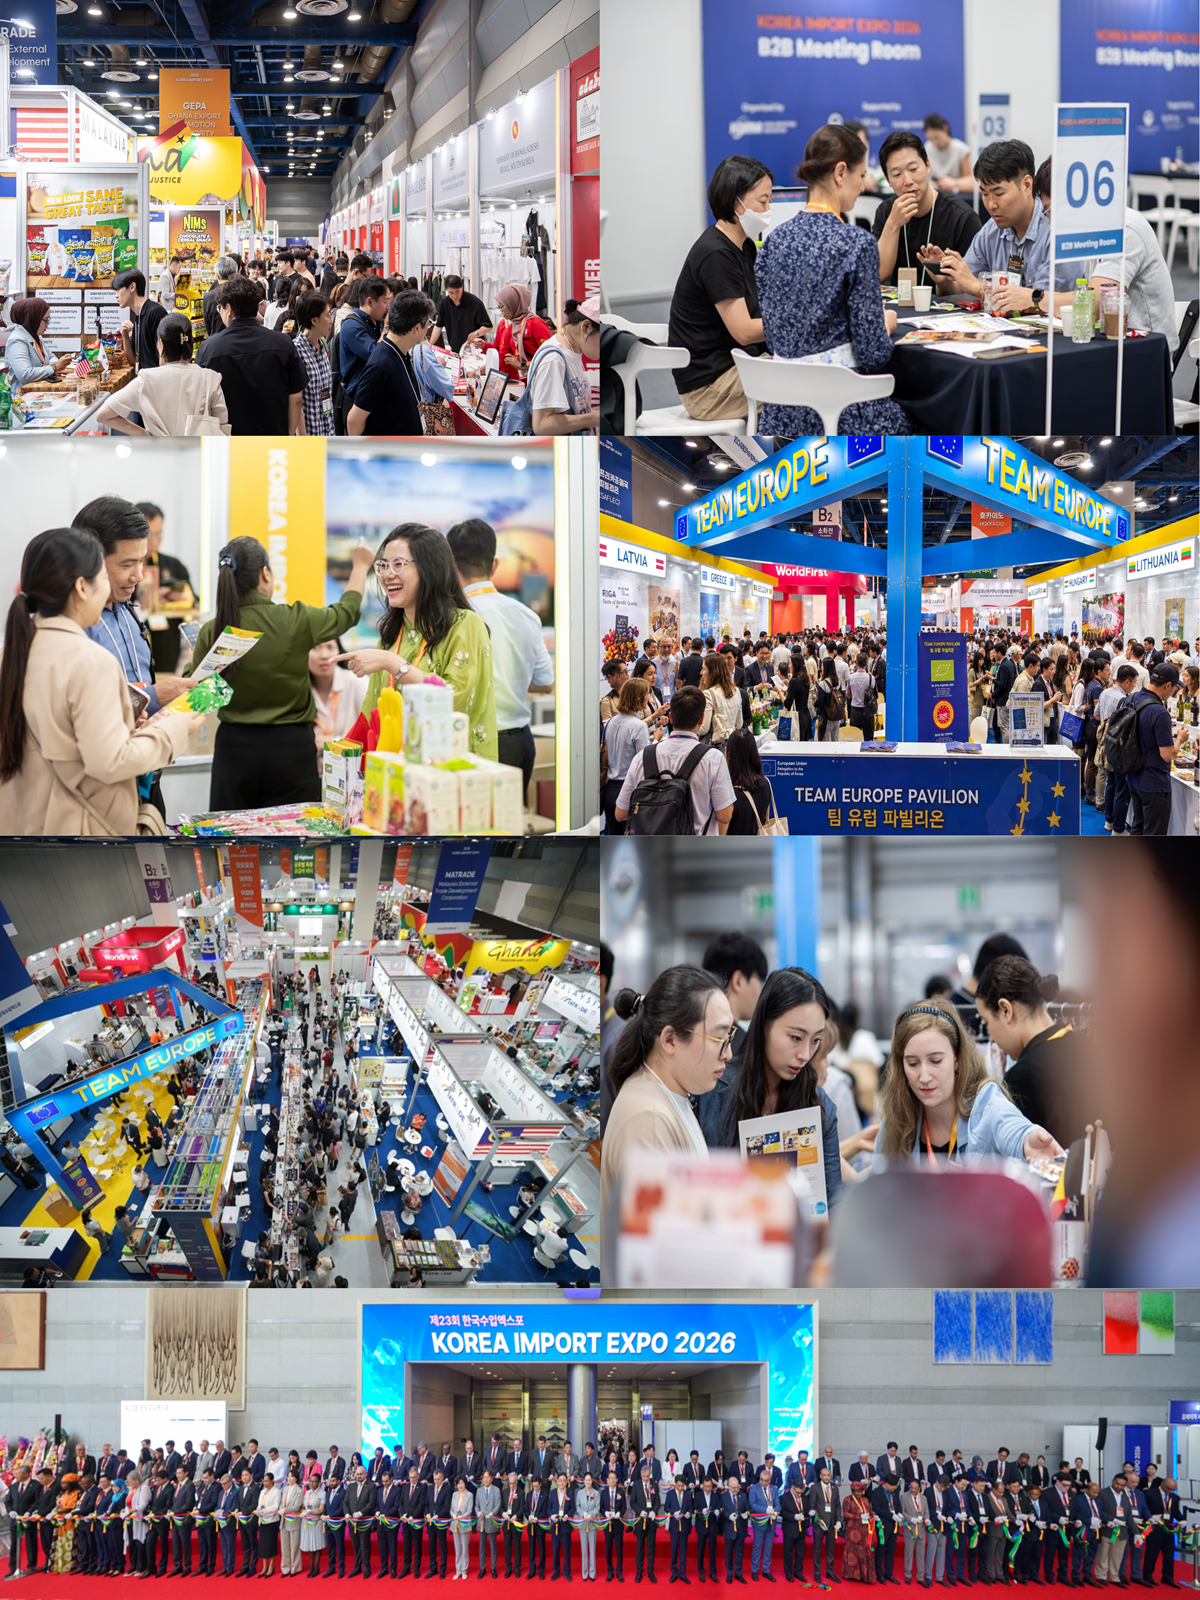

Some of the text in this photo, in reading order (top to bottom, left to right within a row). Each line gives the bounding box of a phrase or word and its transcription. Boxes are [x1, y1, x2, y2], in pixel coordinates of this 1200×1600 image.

[757, 14, 803, 30] KOREA
[806, 16, 854, 32] IMPORT
[857, 18, 891, 34] EXPO
[1096, 28, 1189, 44] KOREA IMPORT EXPO
[757, 36, 922, 65] B2B Meeting Room
[1096, 46, 1174, 71] B2B Meeting
[82, 110, 126, 154] MALAYSIA
[983, 116, 1006, 136] 03
[1066, 160, 1115, 208] 06
[64, 194, 82, 203] LOOK
[86, 187, 123, 202] SAME
[44, 200, 124, 220] GREAT TASTE
[183, 214, 207, 230] NIMS
[1061, 238, 1116, 250] B2B Meeting Room
[695, 490, 733, 534] TEAM
[736, 436, 829, 517] EUROPE
[981, 436, 1111, 536] TEAM EUROPE
[819, 508, 832, 522] B2
[267, 449, 288, 605] KOREA IMPO
[617, 548, 648, 567] LATVIA
[1136, 550, 1179, 572] LITHUANIA
[710, 572, 727, 585] GREECE
[776, 566, 828, 577] WorldFirst
[1069, 576, 1088, 587] HUNGARY
[602, 589, 616, 598] RIGA
[794, 787, 979, 804] TEAM EUROPE PAVILION
[828, 808, 945, 829] 팀 유럽 파빌리온
[144, 864, 158, 876] B2
[488, 944, 544, 961] Ghana
[72, 1027, 217, 1102] TEAM EUROPE
[429, 1314, 524, 1327] 제23회 한국수입엑스포
[431, 1332, 736, 1354] KOREA IMPORT EXPO 2026
